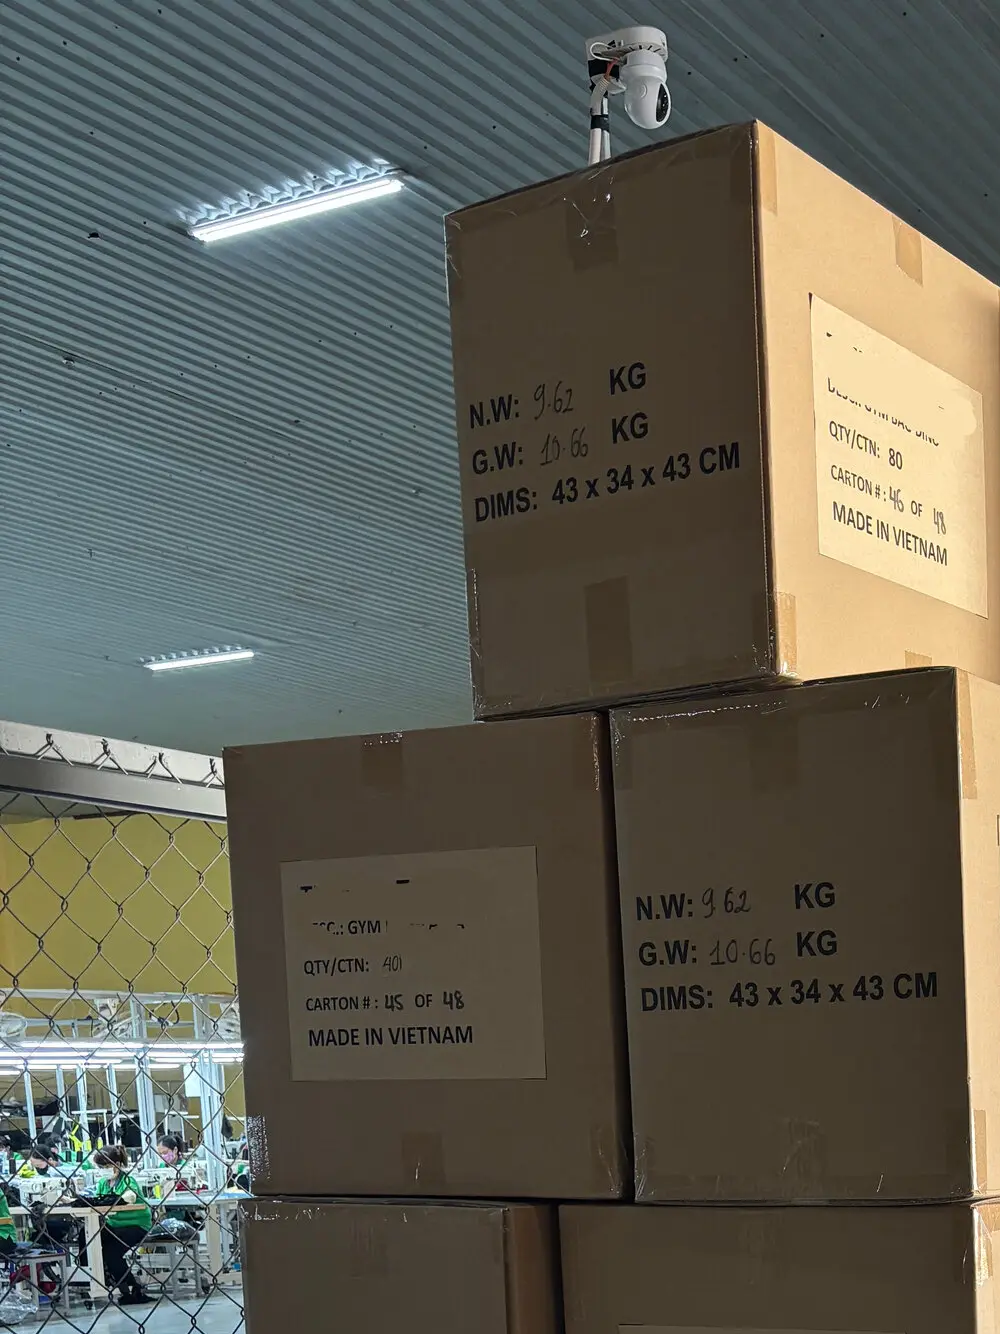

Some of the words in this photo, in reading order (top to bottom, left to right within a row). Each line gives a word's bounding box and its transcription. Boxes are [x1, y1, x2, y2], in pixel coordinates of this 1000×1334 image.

[469, 395, 520, 428] N.W:
[608, 361, 648, 394] KG
[471, 444, 524, 475] G.W:
[611, 411, 649, 444] KG
[829, 420, 880, 459] QTY/CTN:
[888, 448, 903, 470] 80
[474, 487, 538, 523] DIMS:
[551, 477, 579, 506] 43
[606, 467, 635, 496] 34
[662, 454, 691, 483] 43
[699, 442, 740, 475] CM
[830, 464, 873, 496] CARTON
[889, 485, 905, 513] 46
[911, 500, 923, 517] OF
[933, 507, 947, 535] 48
[832, 501, 873, 535] MADE
[876, 519, 890, 542] IN
[893, 526, 948, 566] VIETNAM
[636, 892, 693, 921] N.W:
[794, 882, 836, 909] KG
[347, 920, 381, 935] GYM
[303, 958, 369, 976] QTY/CTN:
[638, 940, 697, 966] G.W:
[709, 937, 776, 966] 10.66
[796, 929, 838, 957] KG
[306, 996, 359, 1011] CARTON
[384, 994, 404, 1012] 45
[414, 994, 433, 1008] OF
[442, 990, 465, 1010] 48
[641, 985, 713, 1011] DIMS:
[729, 981, 759, 1008] 43
[790, 978, 821, 1004] 34
[853, 975, 884, 1001] 43
[894, 972, 938, 999] CM
[308, 1028, 360, 1047] MADE
[365, 1027, 383, 1045] IN
[388, 1025, 474, 1045] VIETNAM
